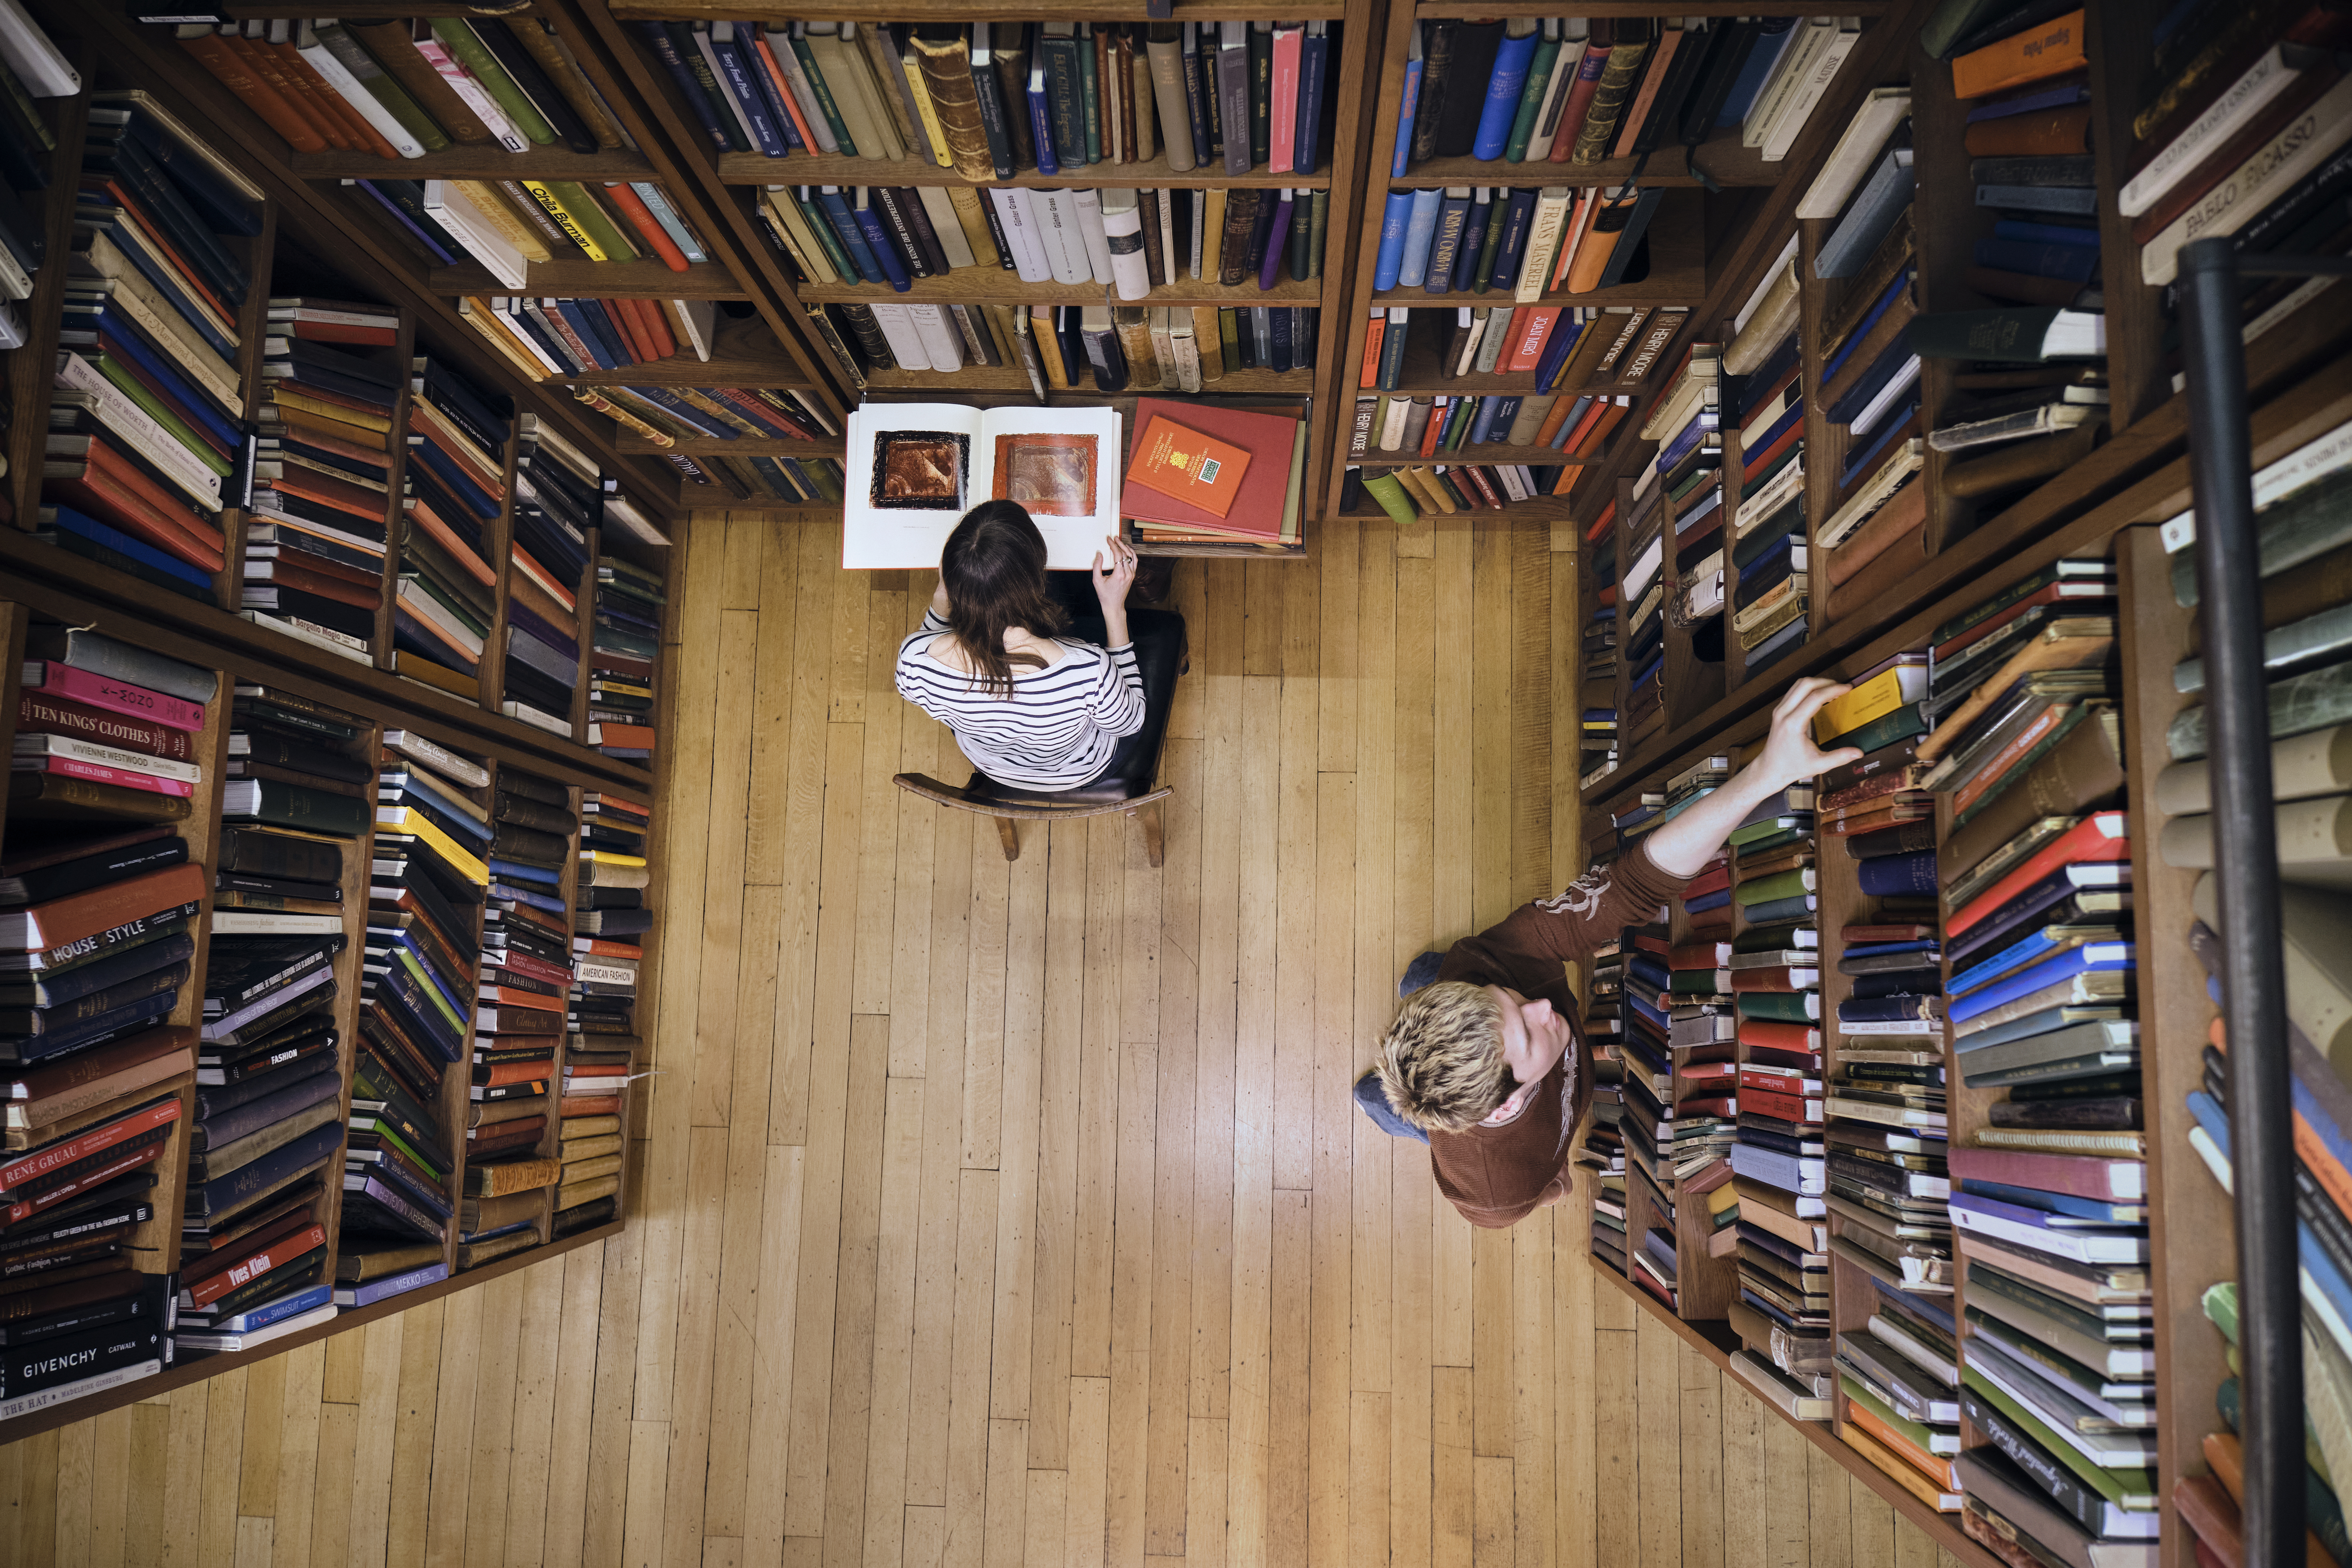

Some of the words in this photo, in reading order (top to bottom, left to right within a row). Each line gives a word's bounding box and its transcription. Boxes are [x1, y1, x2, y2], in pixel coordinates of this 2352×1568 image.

[722, 53, 735, 68] Terry
[730, 68, 743, 82] Frost
[737, 82, 750, 99] Prints
[1816, 55, 1842, 85] MATISSE
[2186, 185, 2236, 238] PABLO
[2245, 114, 2317, 190] PICASSO
[879, 188, 903, 231] INTERPRETATION
[1008, 195, 1017, 209] Grass
[1048, 197, 1057, 212] Grass
[532, 188, 558, 212] Chila
[553, 212, 591, 248] Burman
[1013, 208, 1022, 227] Günter
[1054, 212, 1062, 228] Günter
[1543, 206, 1561, 239] FRANS
[439, 217, 471, 243] BRUEGEL
[900, 231, 911, 243] DER
[905, 242, 919, 259] KUNST
[1433, 240, 1455, 273] MARINO
[914, 258, 922, 269] DIE
[1524, 240, 1551, 292] MASEREEL
[1530, 316, 1549, 338] JOAN
[1621, 312, 1645, 338] HENRY
[1521, 337, 1540, 356] MIRÓ
[1603, 337, 1628, 363] MOORE
[1643, 328, 1672, 354] HENRY
[1626, 352, 1652, 377] MOORE
[73, 364, 88, 381] THE
[87, 378, 113, 403] HOUSE
[112, 397, 124, 409] OF
[123, 403, 149, 432] WORTH
[1355, 412, 1372, 432] HENRY
[1154, 443, 1164, 460] МОТИВЫ
[1352, 430, 1369, 452] MOORE
[1186, 455, 1196, 472] RUSSIAN
[1190, 461, 1203, 486] TRADITIONAL
[1200, 447, 1209, 462] MOTIFS
[1202, 460, 1213, 479] LONDON
[1206, 462, 1216, 481] LIBRARY
[295, 618, 322, 635] Bargello
[322, 626, 341, 641] Magic
[33, 704, 58, 723] TEN
[59, 711, 98, 732] KINGS'
[99, 721, 151, 744] CLOTHES
[72, 743, 107, 760] VIVIENNE
[107, 750, 149, 767] WESTWOOD
[63, 763, 93, 776] CHARLES
[92, 768, 113, 779] JAMES
[410, 811, 446, 850] KIMONO
[51, 936, 99, 963] HOUSE
[105, 920, 146, 943] STYLE
[511, 958, 526, 968] FASHION
[526, 962, 547, 974] ILLUSTRATION
[582, 966, 608, 979] AMERICAN
[609, 968, 631, 981] FASHION
[508, 974, 537, 990] FASHION
[234, 1012, 250, 1025] Dress
[264, 997, 277, 1009] Year
[516, 1015, 536, 1030] Clothing
[537, 1016, 548, 1028] Art
[271, 1049, 298, 1065] FASHION
[6, 1160, 37, 1183] RENÉ
[38, 1145, 78, 1168] GRUAU
[18, 1170, 69, 1197] COMMON
[74, 1144, 128, 1171] THREADS
[36, 1189, 59, 1205] HABILLER
[402, 1171, 419, 1190] Century
[417, 1182, 435, 1199] Fashion
[378, 1186, 409, 1216] MUGLER
[53, 1229, 69, 1239] FELICITY
[69, 1225, 82, 1235] GREEN
[102, 1216, 118, 1227] FASHION
[118, 1214, 130, 1223] SCENE
[407, 1209, 436, 1236] THIERRY
[5, 1262, 26, 1276] Gothic
[26, 1258, 52, 1271] Fashion
[228, 1265, 250, 1286] Yves
[248, 1254, 271, 1277] Klein
[271, 1300, 299, 1319] SWIMSUIT
[23, 1348, 97, 1378] GIVENCHY
[108, 1340, 136, 1354] CATWALK
[61, 1382, 94, 1398] MADELEINE
[95, 1374, 124, 1388] GINSBURG
[3, 1401, 24, 1416] THE
[28, 1395, 48, 1409] HAT
